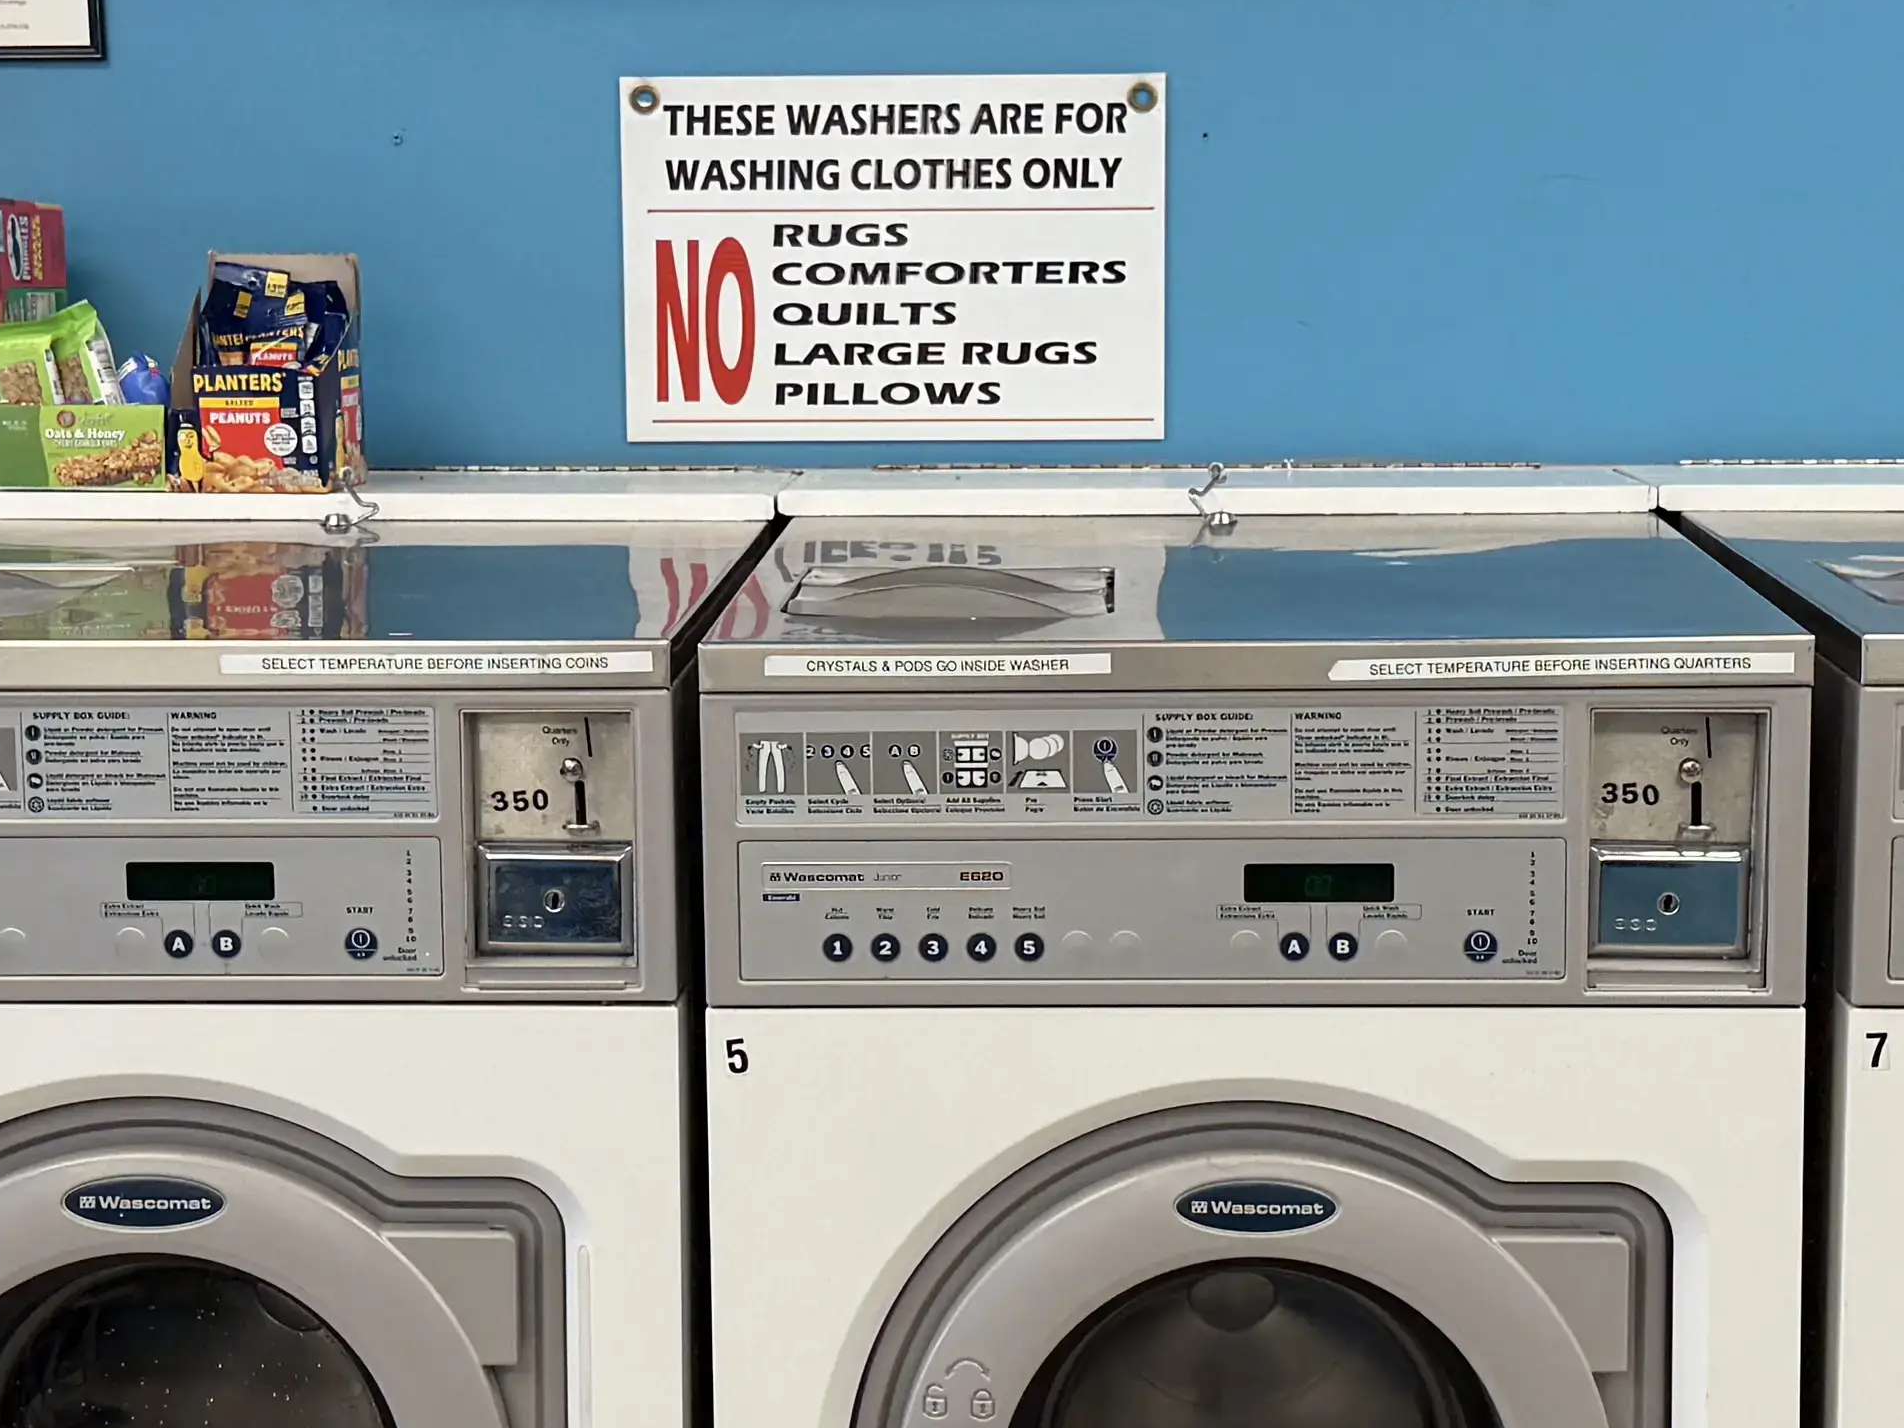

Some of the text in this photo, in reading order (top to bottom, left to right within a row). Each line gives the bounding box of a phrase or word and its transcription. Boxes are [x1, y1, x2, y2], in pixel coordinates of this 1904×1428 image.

[663, 102, 1128, 136] THESE WASHERS ARE FOR
[665, 157, 1123, 191] WASHING CLOTHES ONLY
[772, 223, 908, 248] RUGS
[772, 260, 1127, 286] COMFORTERS
[656, 236, 755, 405] NO
[772, 301, 957, 326] QUILTS
[774, 341, 1098, 366] LARGE RUGS
[193, 374, 283, 393] PLANTERS
[774, 381, 1002, 406] PILLOWS
[209, 412, 271, 424] PEANUTS
[45, 427, 126, 442] Oats & Honey
[491, 789, 549, 811] 350
[1601, 782, 1660, 806] 350
[726, 1038, 748, 1073] 5
[1865, 1032, 1888, 1068] 7
[99, 1195, 212, 1210] Wascomat
[1211, 1200, 1325, 1215] Wascomat
